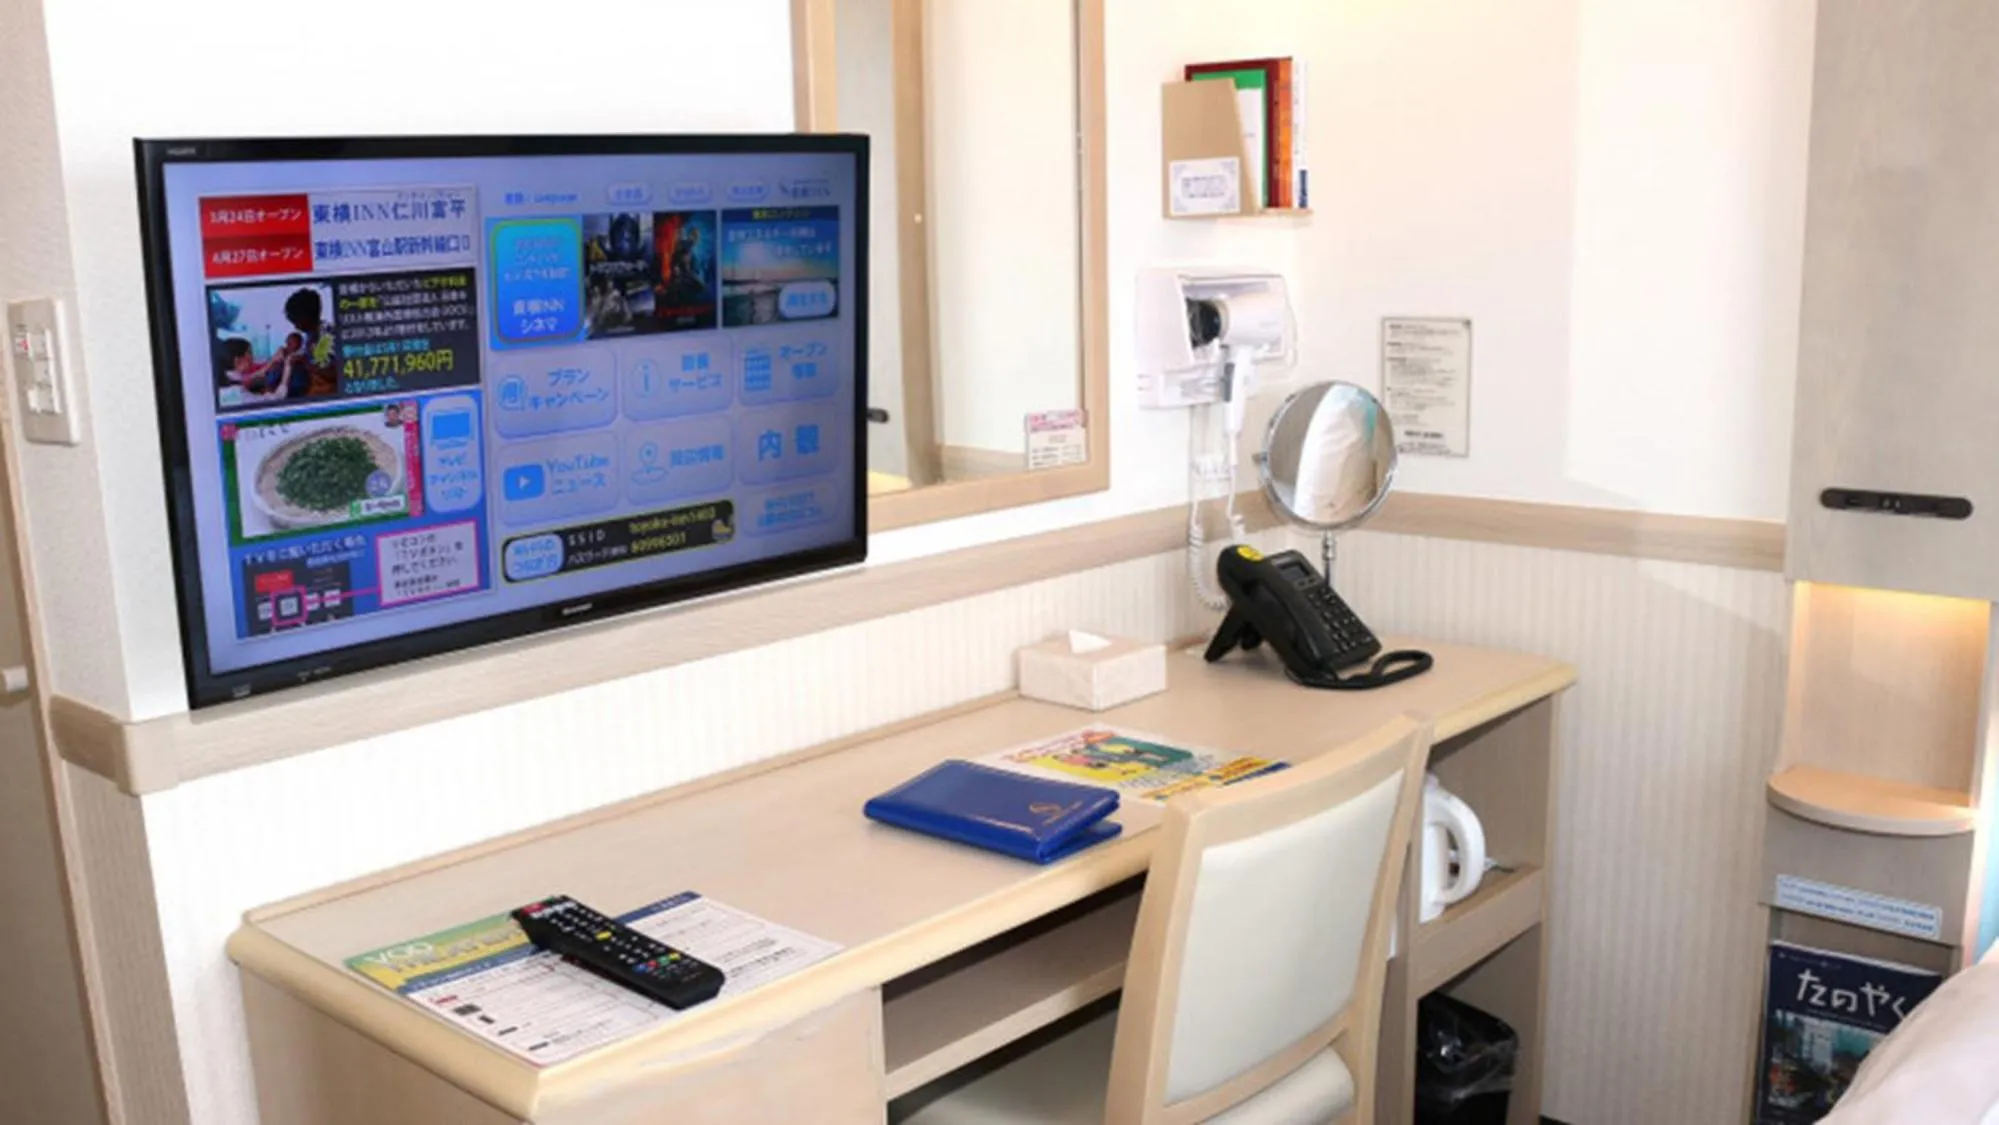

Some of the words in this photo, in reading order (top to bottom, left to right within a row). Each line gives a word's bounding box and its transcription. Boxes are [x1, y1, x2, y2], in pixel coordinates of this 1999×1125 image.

[547, 369, 590, 387] プラン
[529, 388, 609, 410] キャンペーン
[547, 456, 609, 472] YouTube
[551, 473, 606, 494] ニュース
